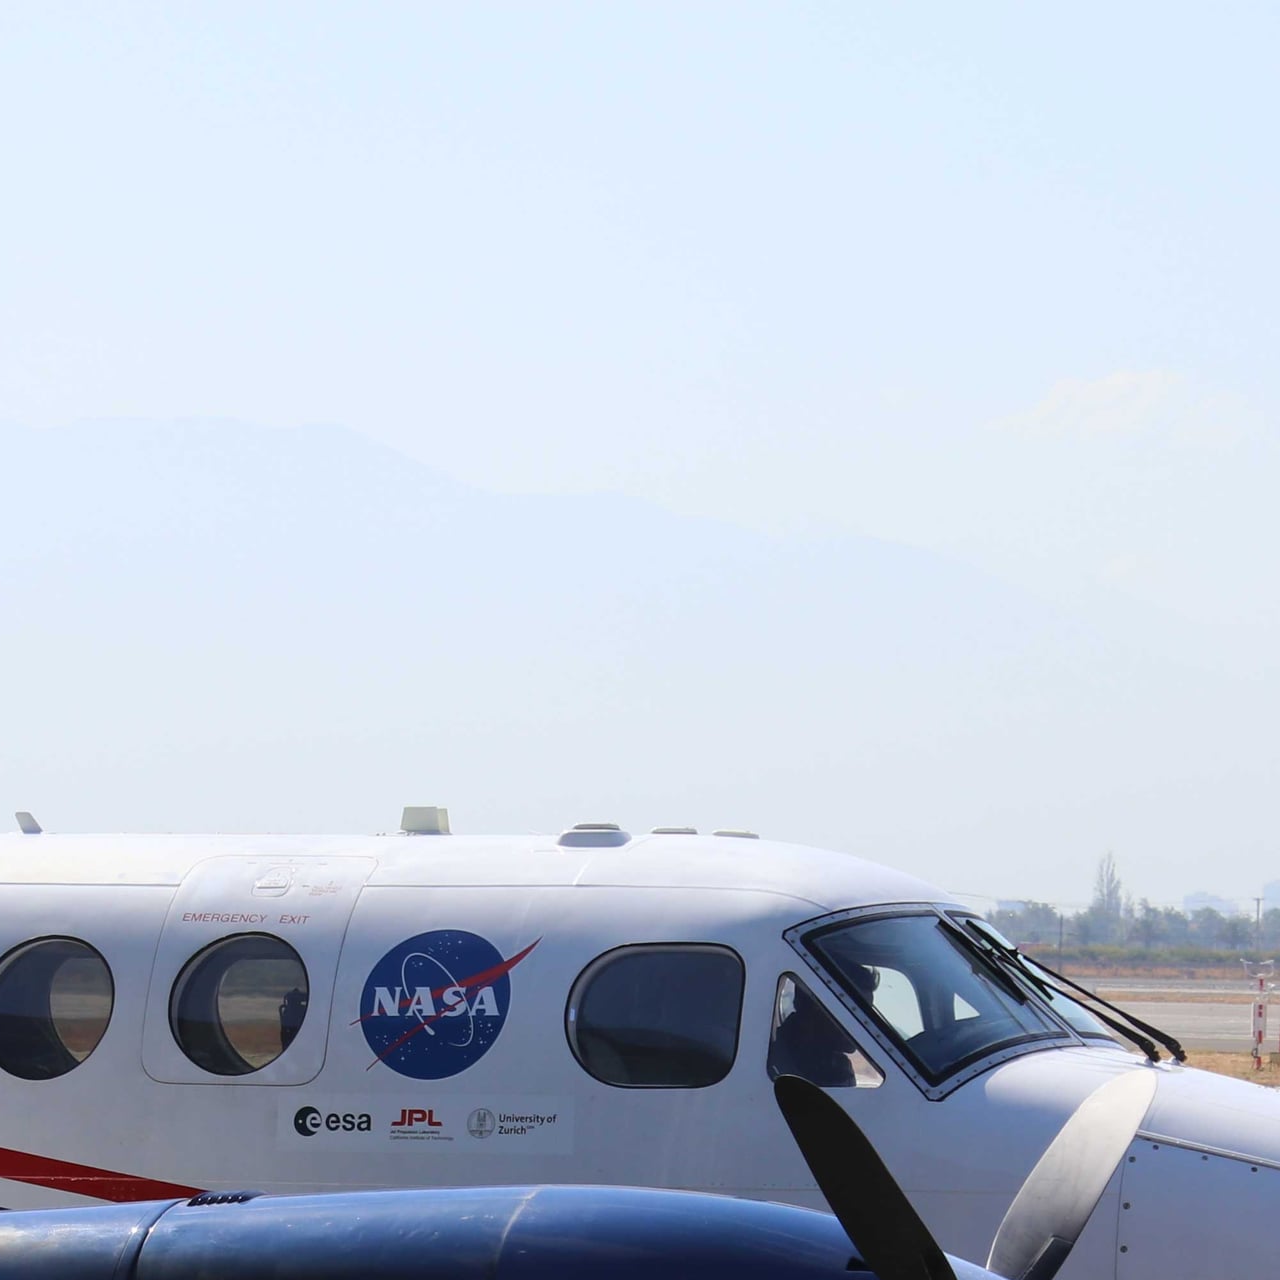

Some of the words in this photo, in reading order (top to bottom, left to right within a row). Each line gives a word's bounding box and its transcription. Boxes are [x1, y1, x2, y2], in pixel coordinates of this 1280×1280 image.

[182, 912, 268, 924] EMERGENCY
[279, 914, 311, 925] EXIT
[370, 986, 500, 1018] NASA
[325, 1113, 371, 1132] esa
[391, 1109, 443, 1126] JPL
[498, 1114, 545, 1126] University
[546, 1114, 558, 1124] of
[498, 1126, 527, 1135] Zurich
